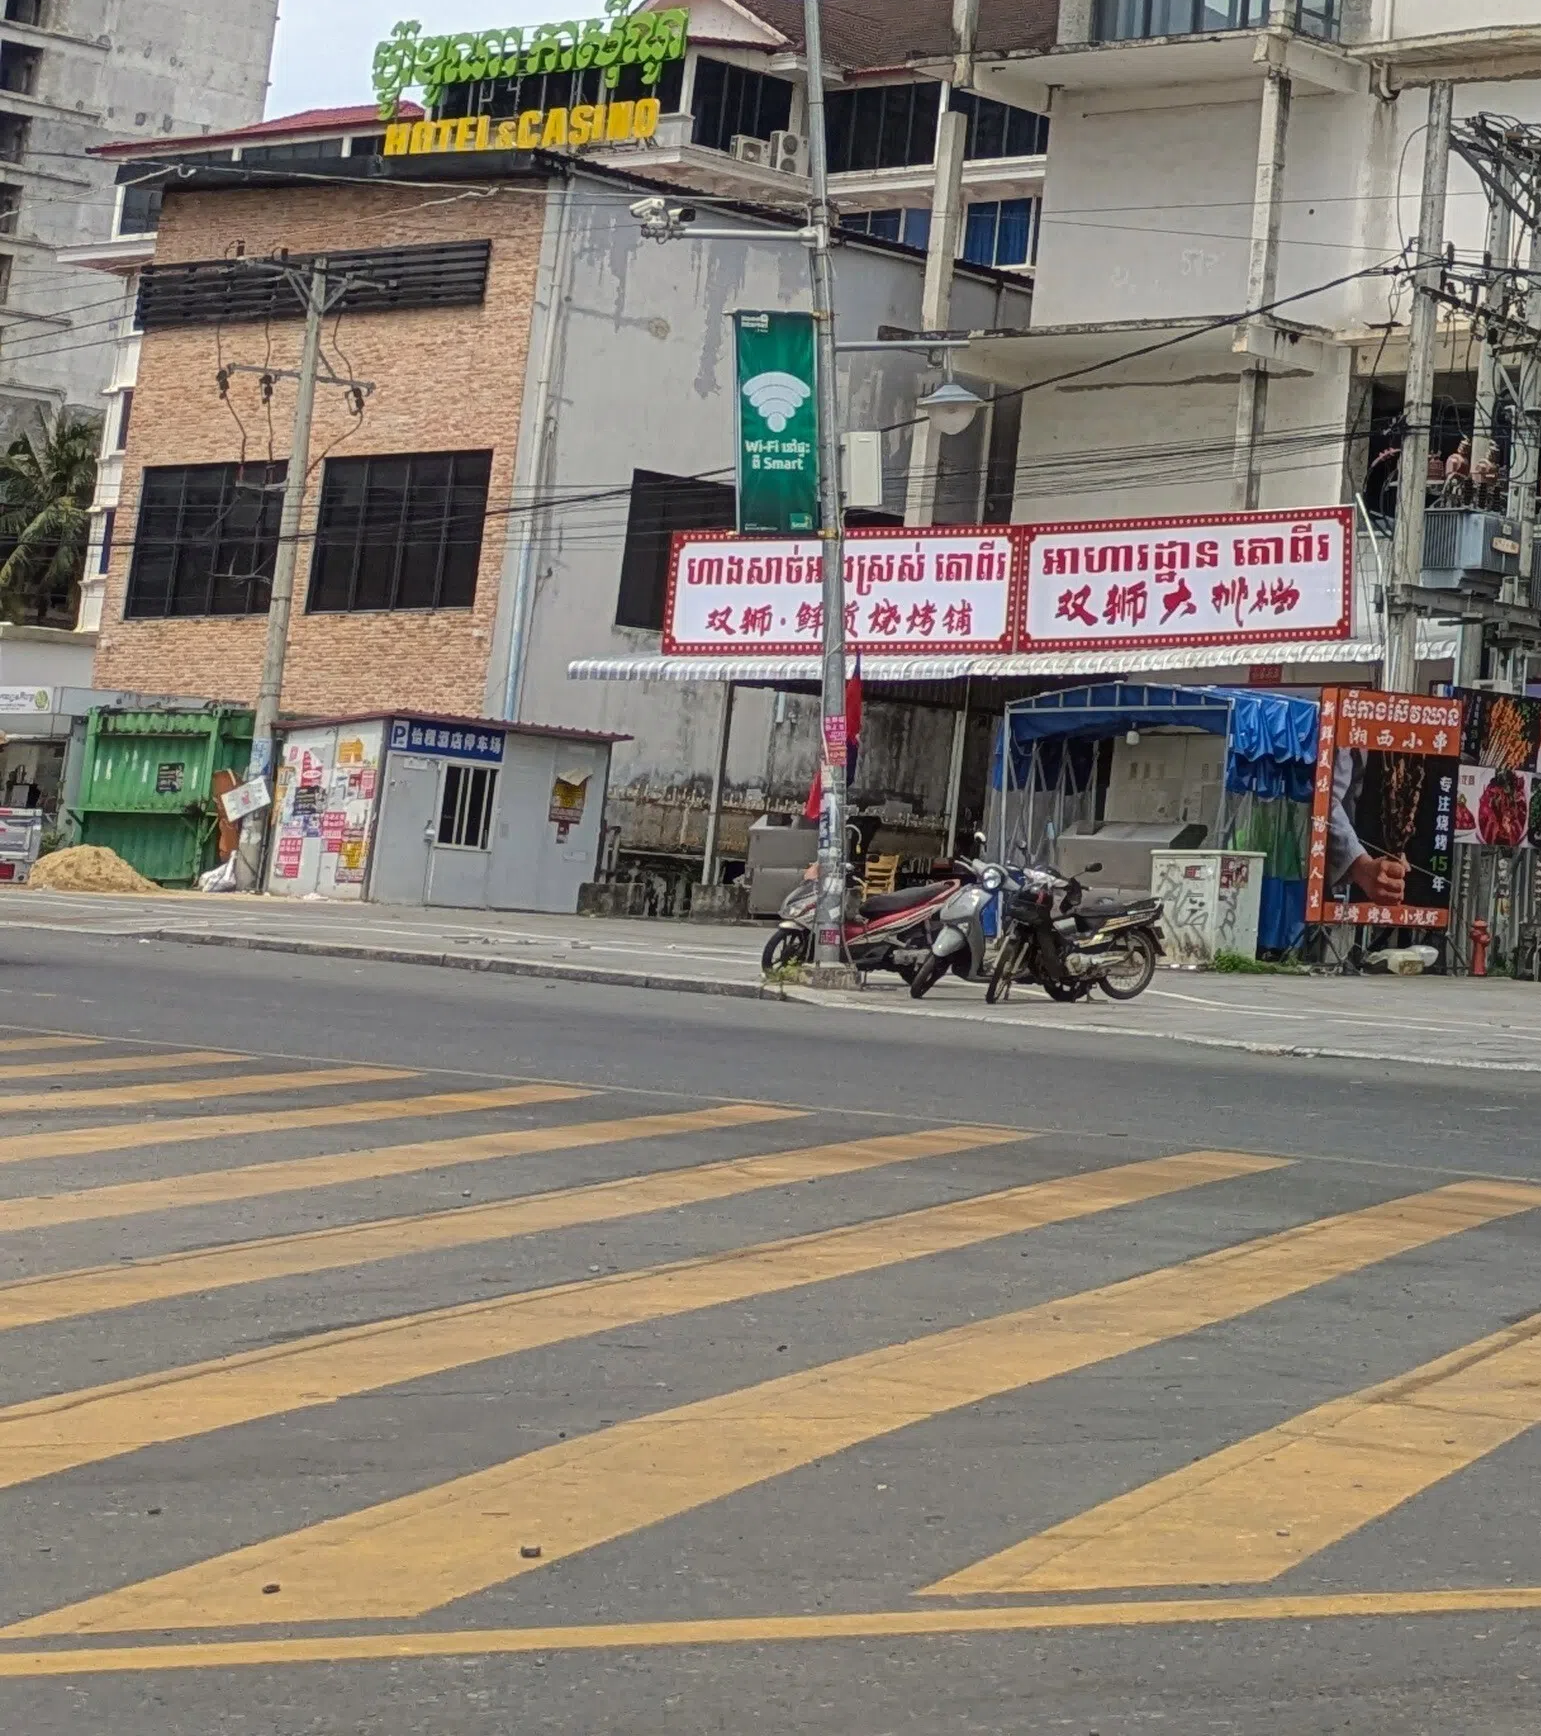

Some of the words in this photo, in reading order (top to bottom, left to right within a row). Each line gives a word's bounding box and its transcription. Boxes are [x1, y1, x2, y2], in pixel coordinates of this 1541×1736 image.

[383, 114, 491, 156] HOTEL
[517, 97, 662, 149] CASINO
[744, 439, 779, 453] Wi-Fi
[763, 455, 804, 471] Smart
[393, 725, 406, 746] P
[1349, 728, 1449, 753] 湘西小串
